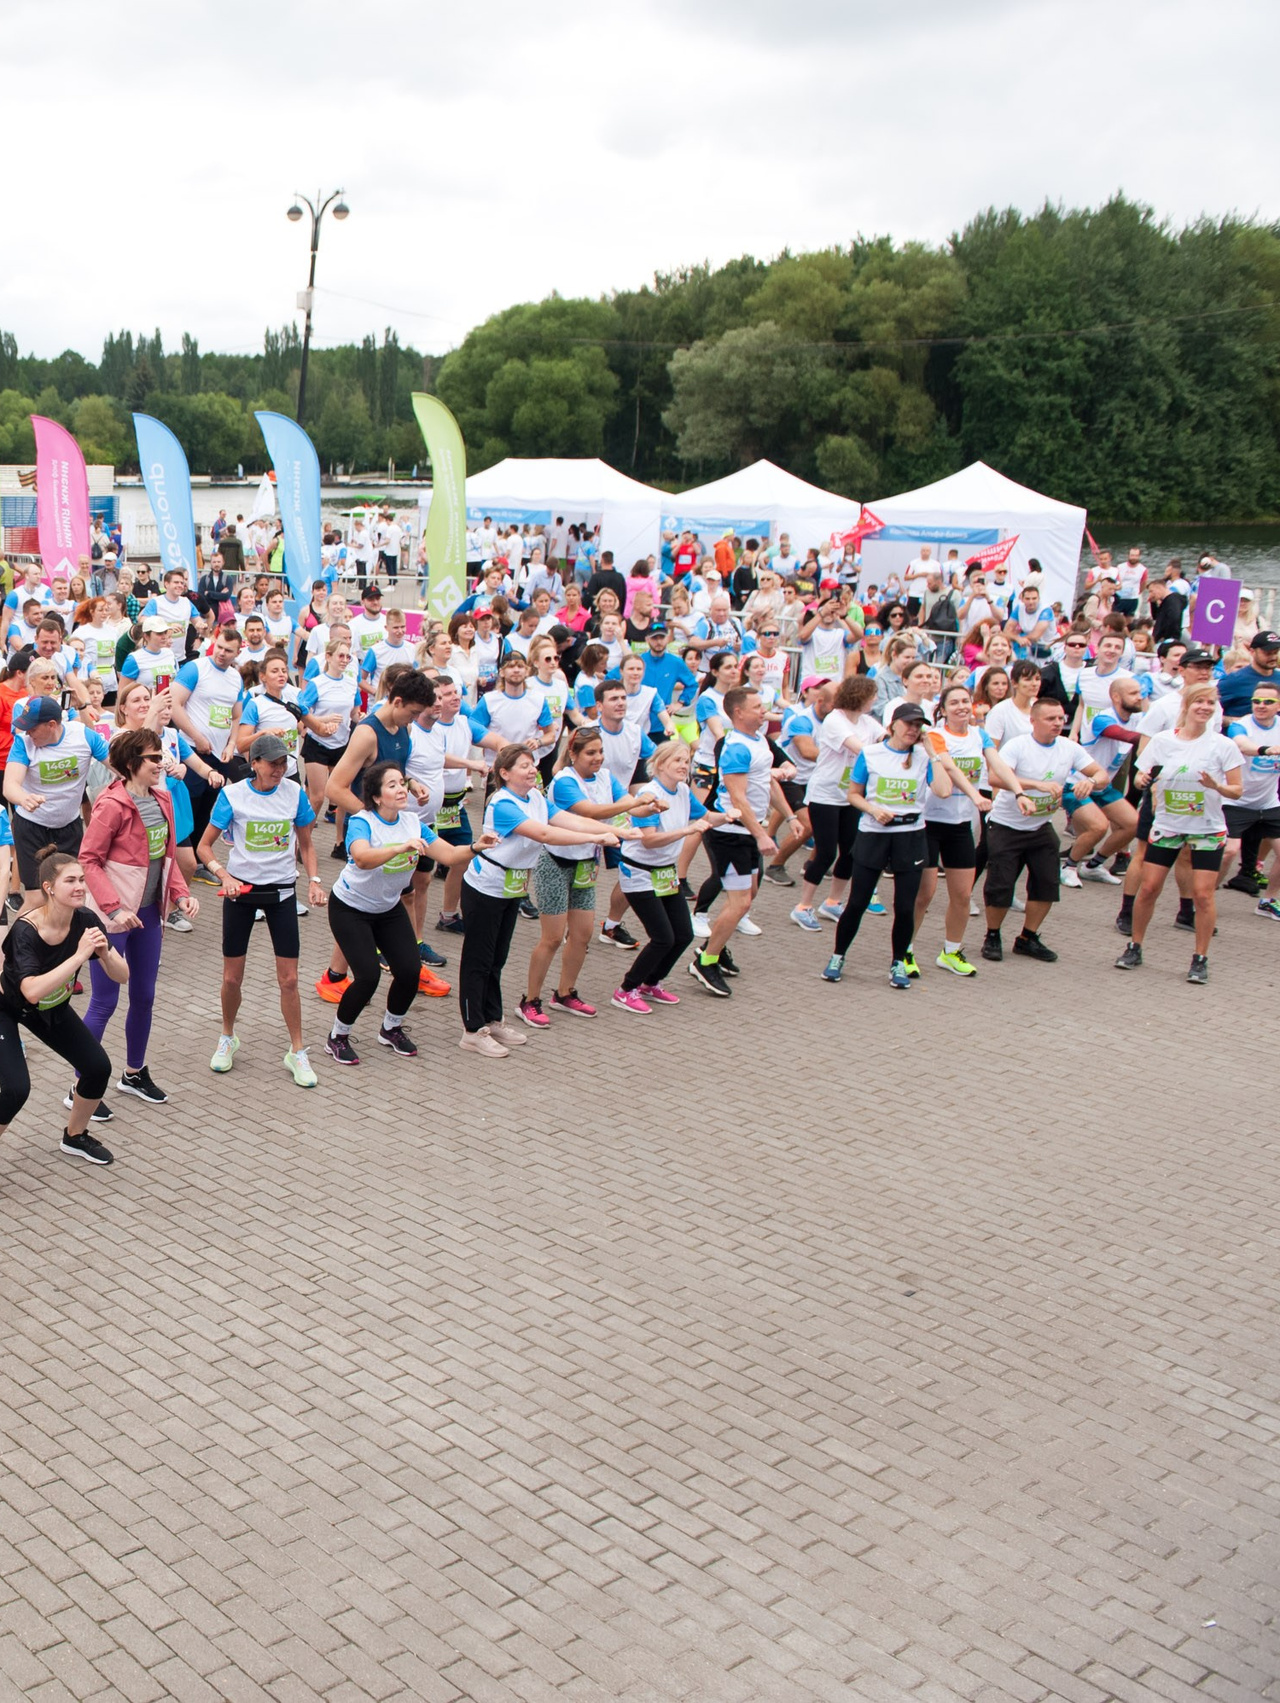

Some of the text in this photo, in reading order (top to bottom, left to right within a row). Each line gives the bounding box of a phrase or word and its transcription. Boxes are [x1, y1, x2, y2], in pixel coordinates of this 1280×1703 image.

[1206, 599, 1225, 624] C
[45, 760, 72, 772] 1462
[957, 759, 975, 769] 1191
[884, 779, 910, 790] 1210
[1170, 791, 1197, 802] 1355
[253, 823, 284, 835] 1407
